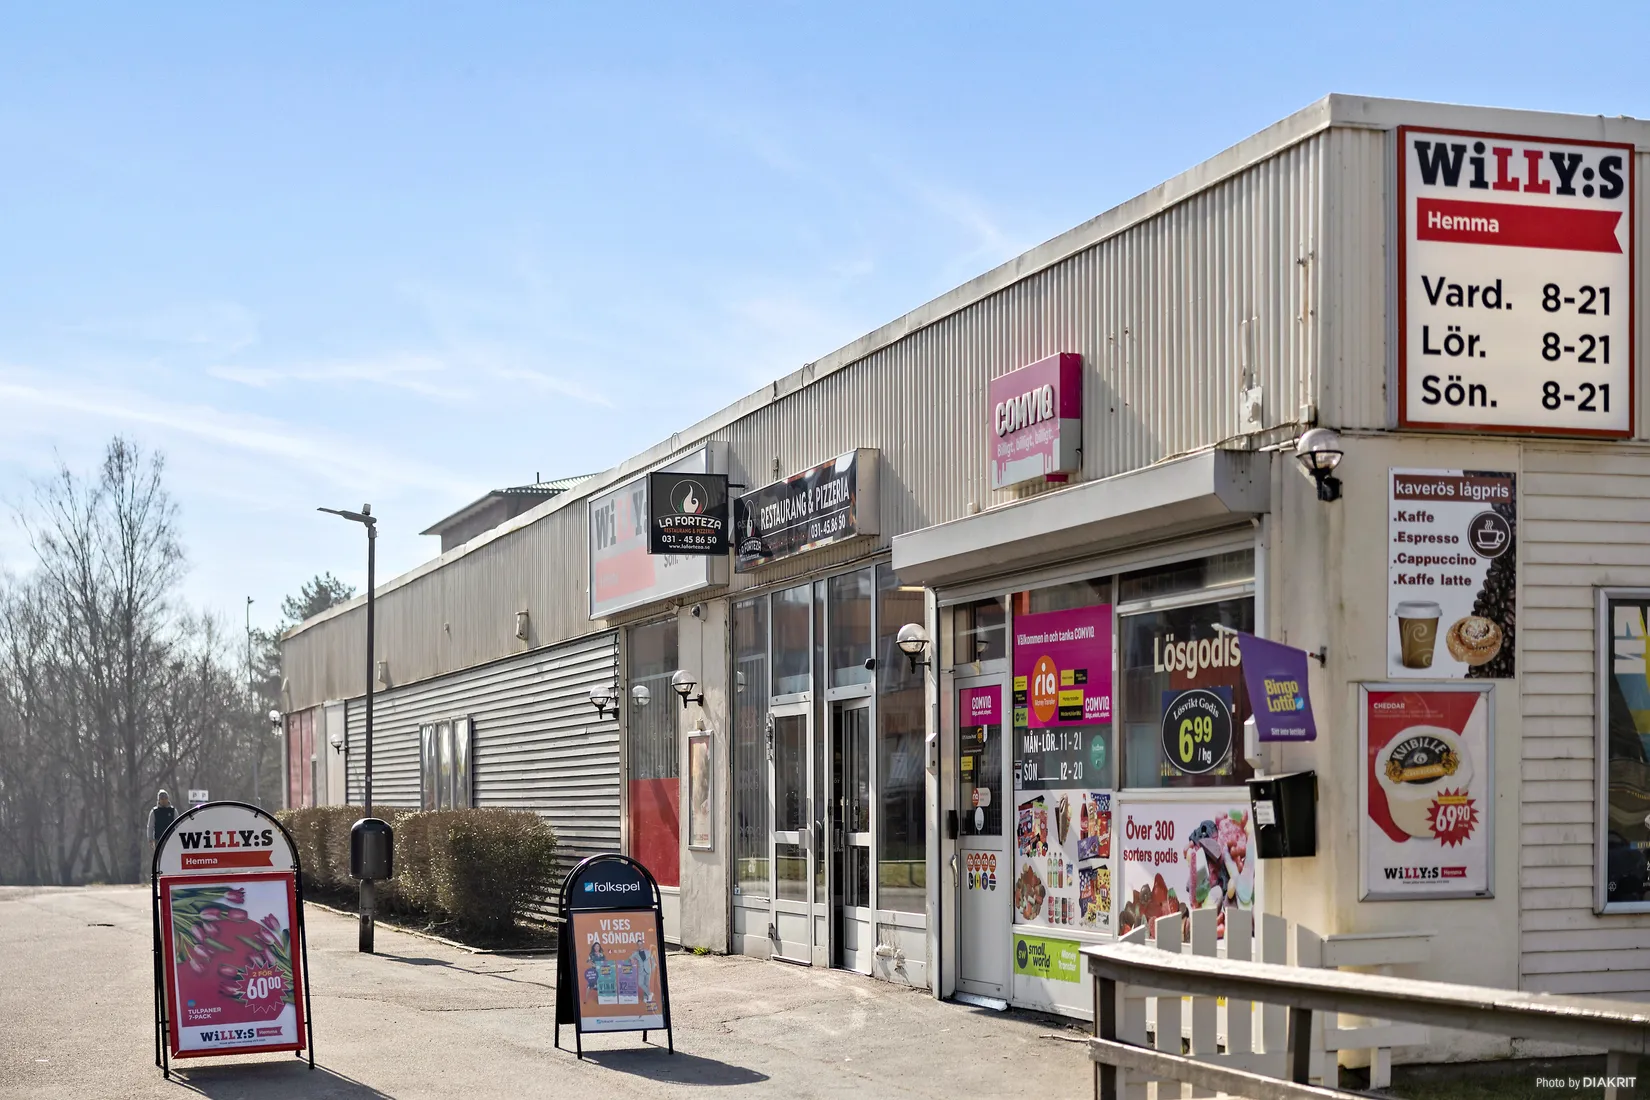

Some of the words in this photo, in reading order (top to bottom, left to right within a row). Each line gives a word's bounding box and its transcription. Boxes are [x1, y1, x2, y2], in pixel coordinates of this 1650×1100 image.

[1414, 140, 1624, 199] WiLLY:S
[1428, 211, 1499, 233] Hemma
[1421, 275, 1512, 310] Vard.
[1542, 283, 1610, 315] 8-21
[1422, 325, 1486, 358] Lör.
[1542, 332, 1610, 364] 8-21
[1422, 375, 1497, 407] Sön.
[1542, 381, 1610, 412] 8-21
[995, 384, 1054, 436] COMVIQ
[1396, 480, 1454, 496] kaverös
[1460, 482, 1509, 500] lågpris
[760, 491, 807, 530] RESTAURANG
[808, 489, 814, 514] &
[816, 475, 849, 511] PIZZERIA
[658, 517, 673, 528] LA
[675, 516, 722, 530] FORTEZA
[662, 535, 676, 543] 031
[684, 535, 693, 543] 45
[707, 536, 717, 544] 50
[1441, 574, 1472, 586] latte
[1017, 634, 1044, 646] Välkommen
[1050, 630, 1059, 642] och
[1154, 629, 1241, 679] Lösgodis
[1035, 662, 1056, 696] ria
[1264, 678, 1299, 698] Bingo
[1085, 696, 1110, 711] COMVIQ
[1173, 698, 1198, 720] Lösvikt
[1199, 697, 1219, 718] Godis
[1266, 695, 1296, 712] Lotto
[1074, 732, 1082, 750] 21
[1392, 737, 1447, 760] KVIBILLE
[1202, 747, 1212, 764] hg
[1060, 762, 1067, 780] 12
[1073, 761, 1083, 780] 20
[1126, 815, 1152, 840] Över
[1155, 820, 1174, 841] 300
[179, 829, 273, 850] WiLLY:S
[185, 857, 218, 865] Hemma
[1123, 847, 1152, 862] sorters
[1154, 848, 1178, 867] godis
[1384, 866, 1439, 879] WiLLY:S
[594, 881, 640, 893] folkspel
[600, 919, 611, 931] VI
[612, 918, 631, 931] SES
[587, 931, 600, 945] PÅ
[1028, 942, 1046, 956] small
[1032, 954, 1051, 968] world
[188, 1007, 222, 1015] TULPANER
[200, 1028, 255, 1042] WiLLY:S
